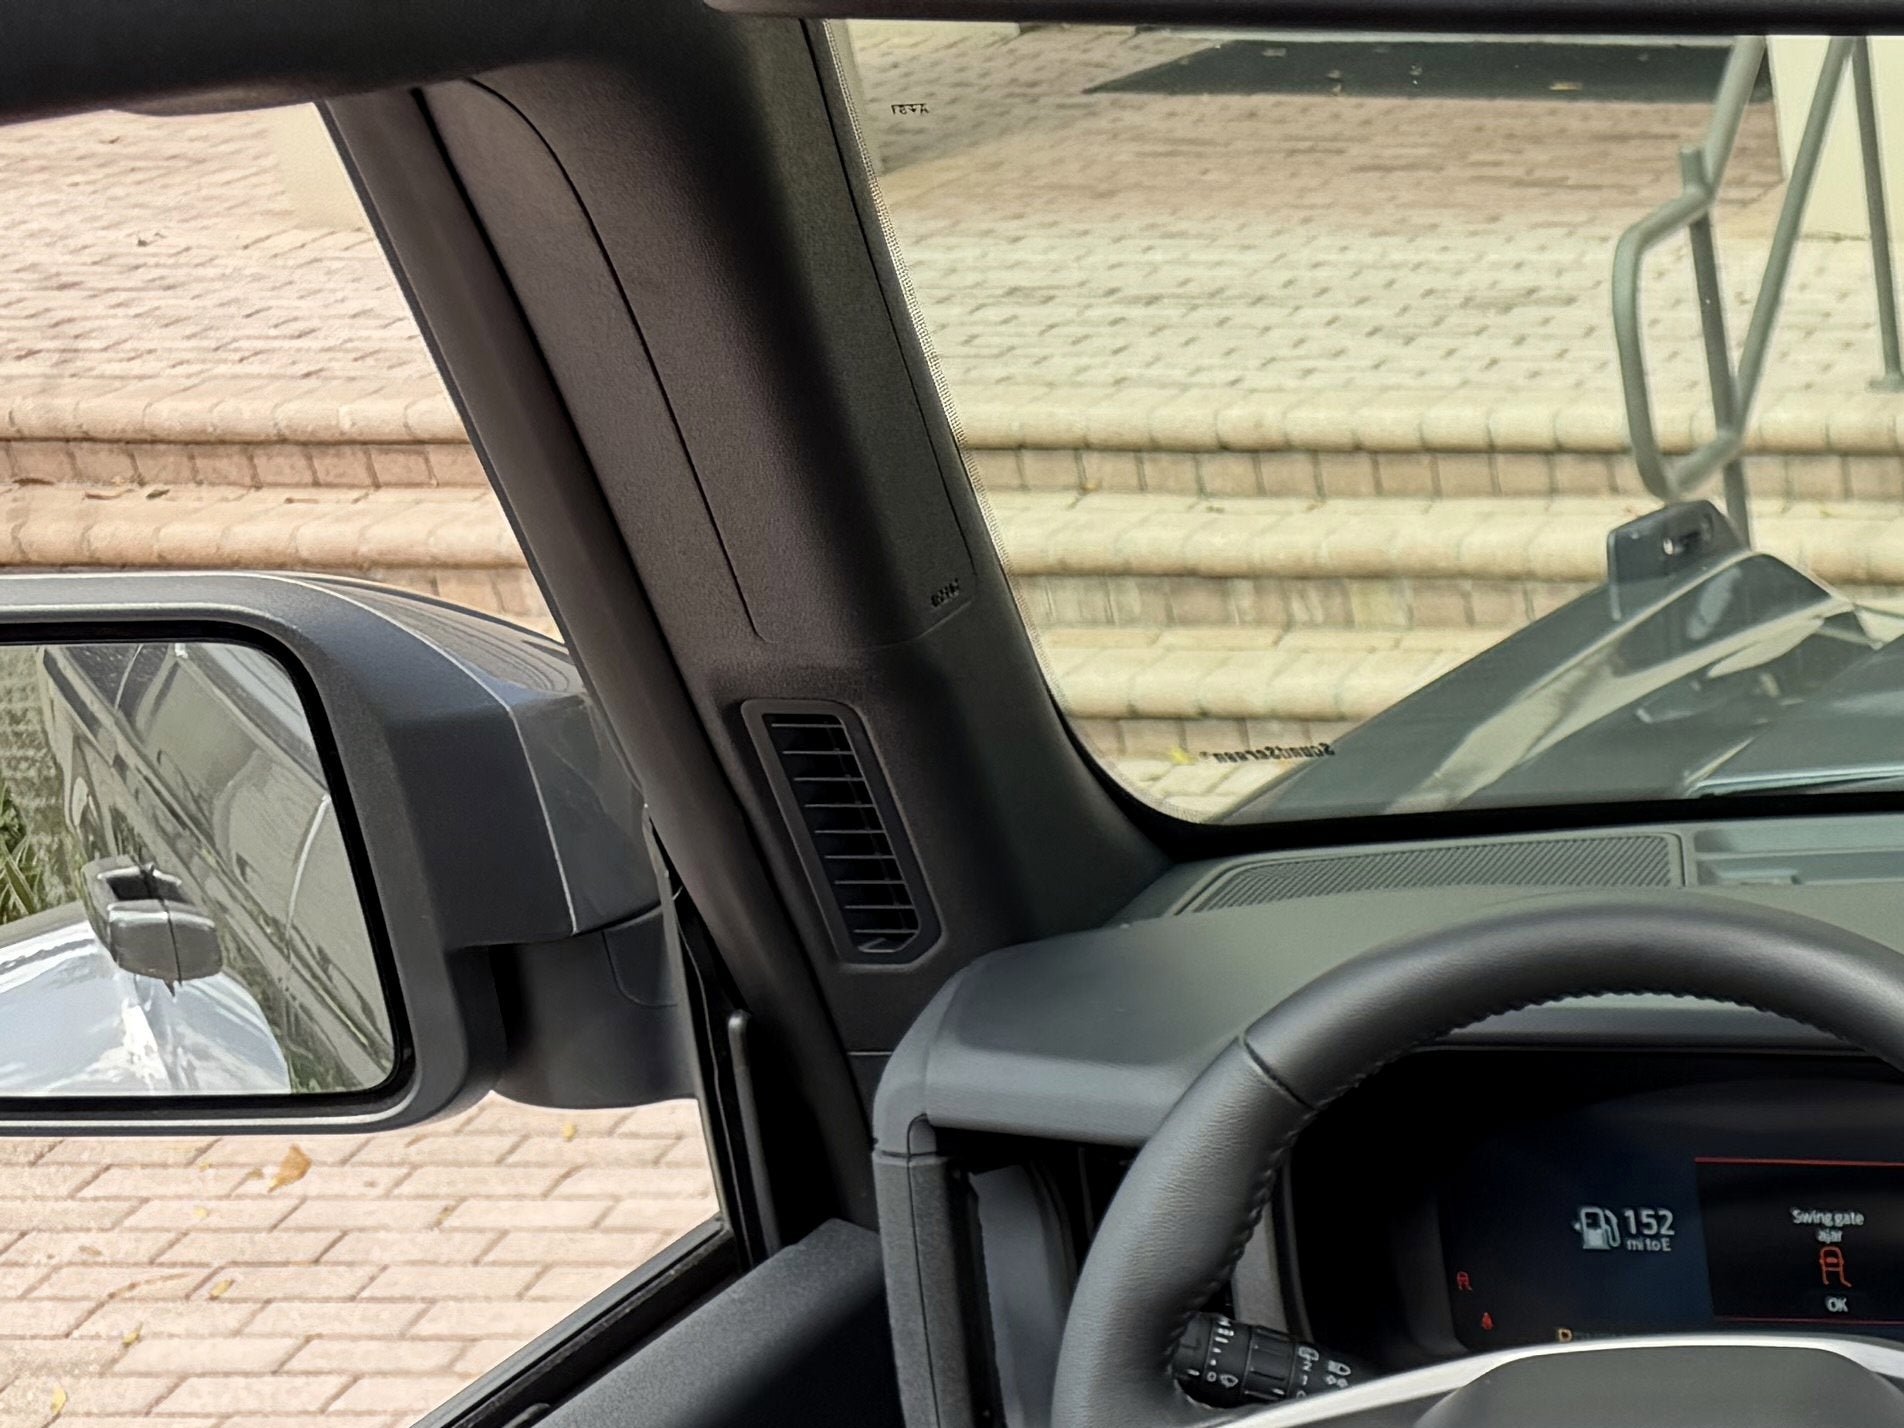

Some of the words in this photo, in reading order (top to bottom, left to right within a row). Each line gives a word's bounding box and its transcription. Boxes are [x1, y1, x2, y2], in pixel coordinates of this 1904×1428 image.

[1624, 1209, 1676, 1236] 152
[1792, 1209, 1832, 1226] Swing
[1834, 1211, 1865, 1227] gate
[1816, 1229, 1843, 1243] ajar
[1826, 1297, 1848, 1312] OK
